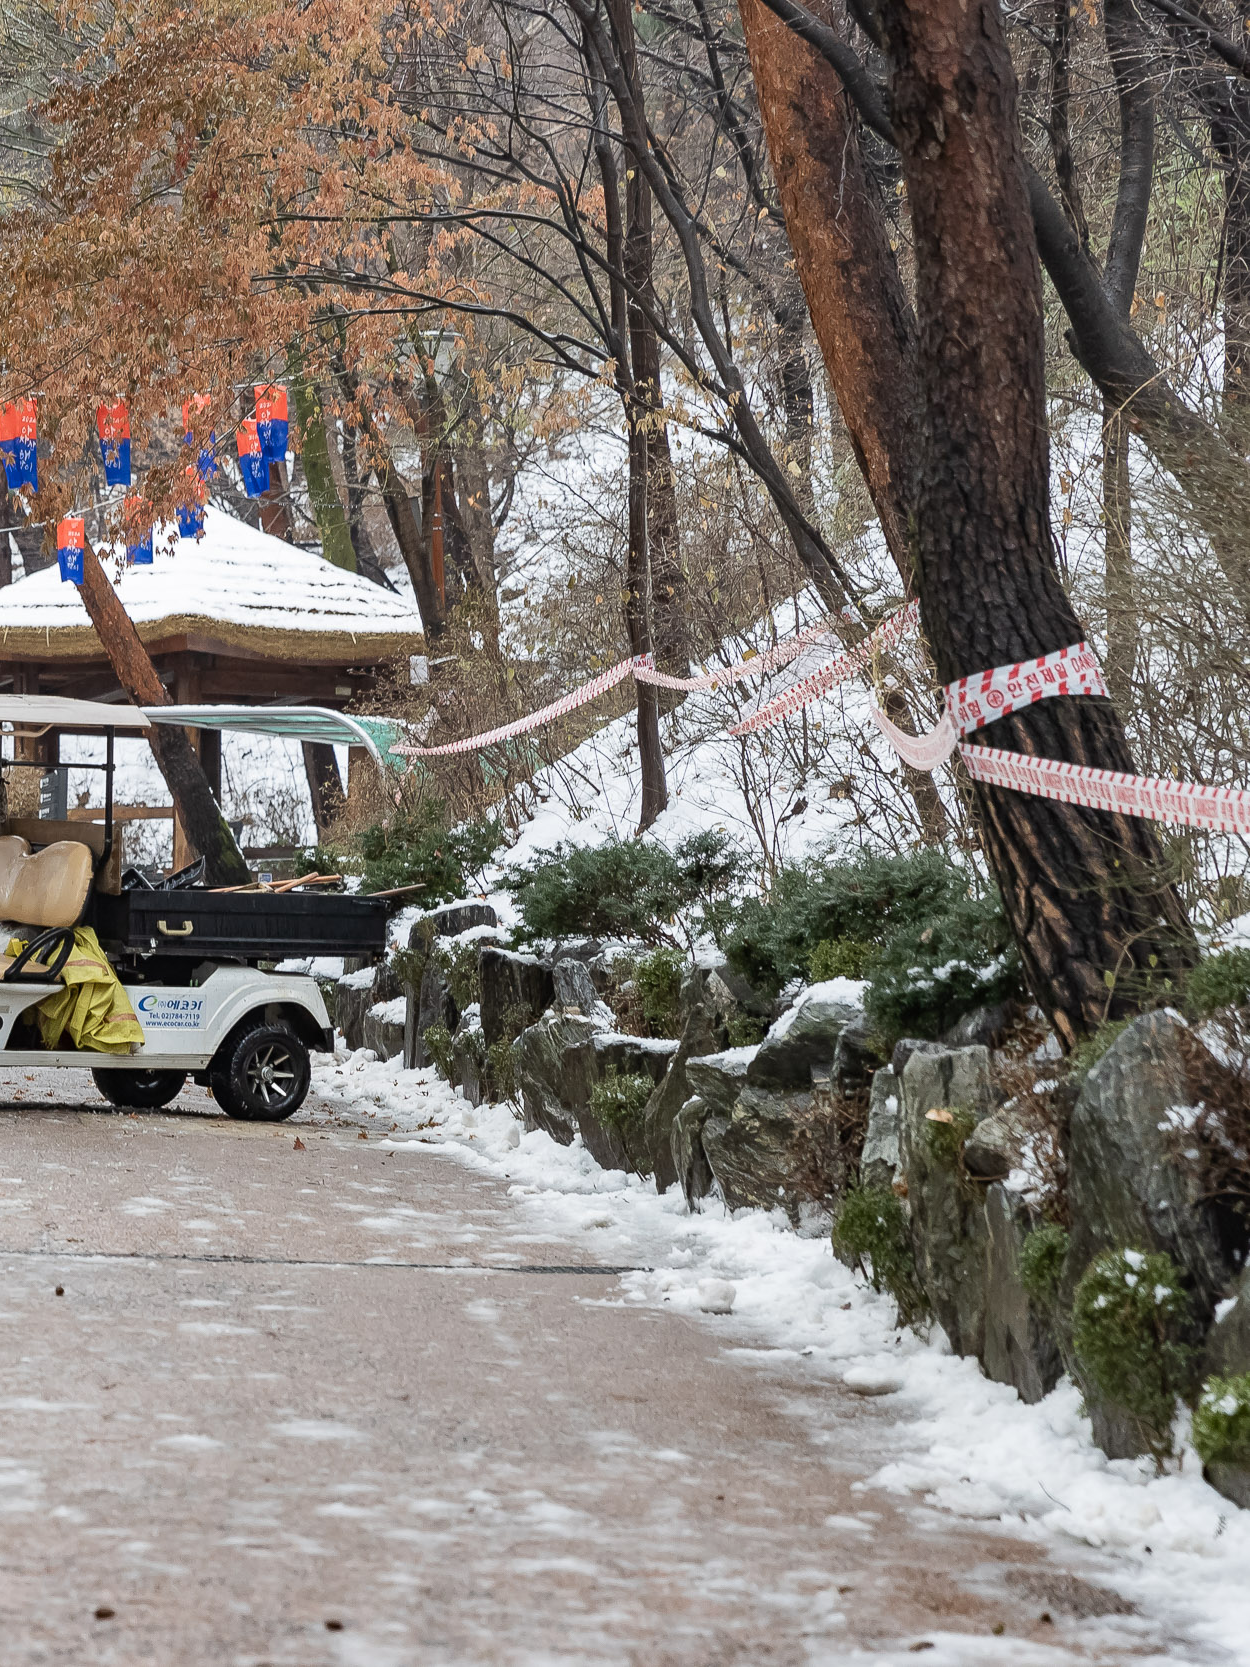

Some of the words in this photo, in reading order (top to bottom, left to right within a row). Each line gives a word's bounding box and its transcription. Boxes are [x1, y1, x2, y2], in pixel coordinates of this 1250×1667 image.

[958, 699, 982, 724] 위험
[1007, 662, 1069, 699] 안전제일
[145, 1020, 200, 1028] www.ecocar.co.kr
